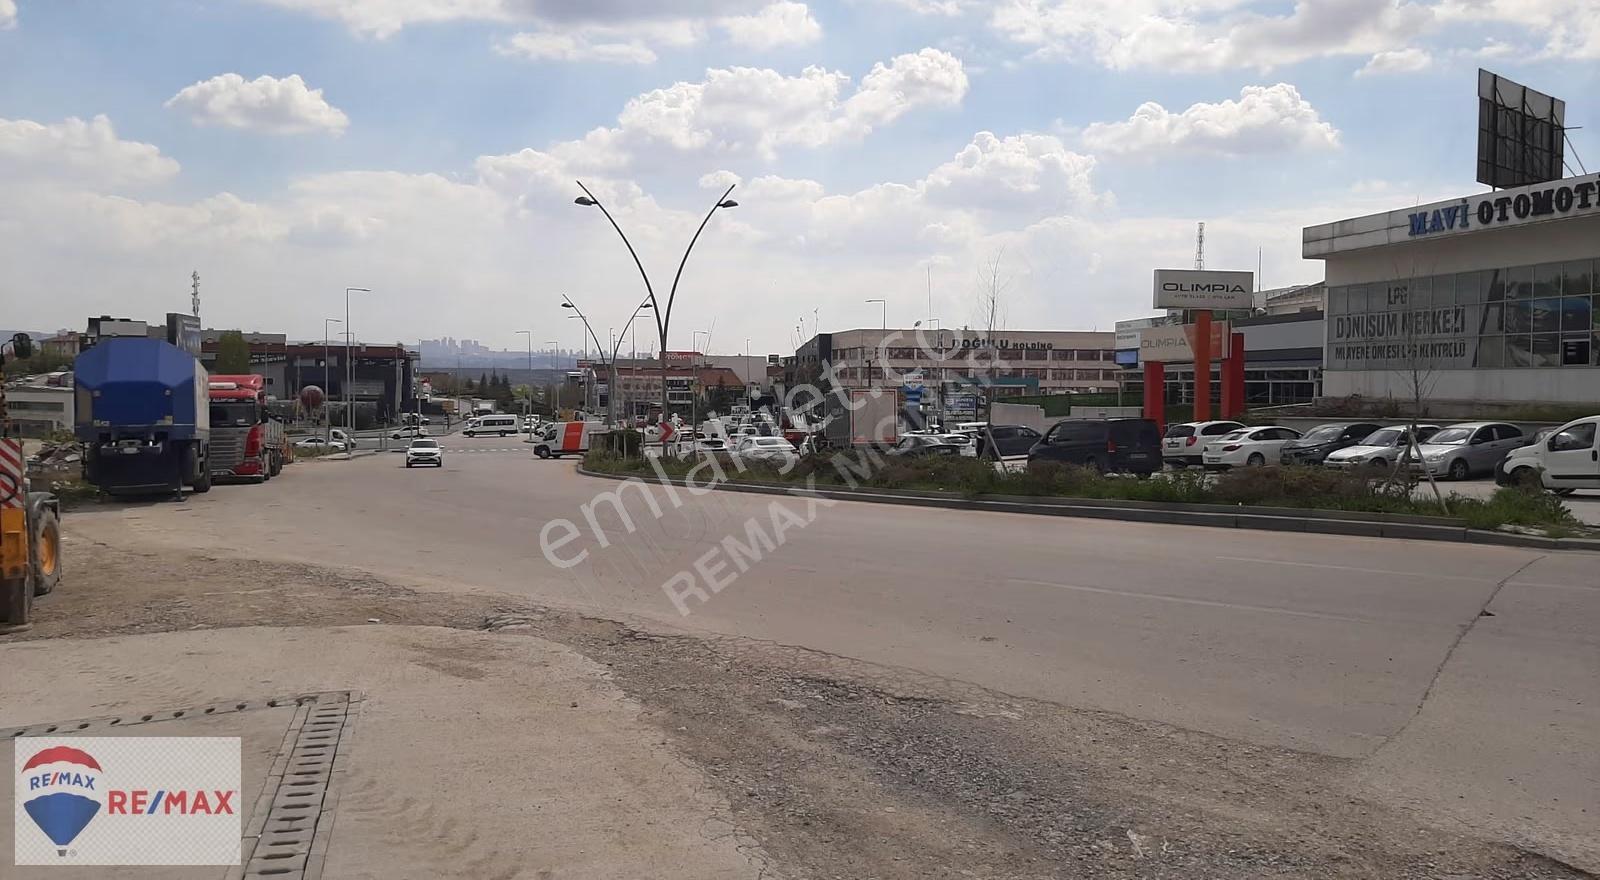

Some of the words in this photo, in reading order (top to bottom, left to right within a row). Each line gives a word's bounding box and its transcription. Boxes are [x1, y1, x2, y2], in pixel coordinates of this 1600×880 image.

[1409, 198, 1470, 236] MAVİ
[1162, 282, 1246, 293] OLIMPIA
[1387, 287, 1407, 305] LPG
[1140, 337, 1187, 349] OLIMPIA
